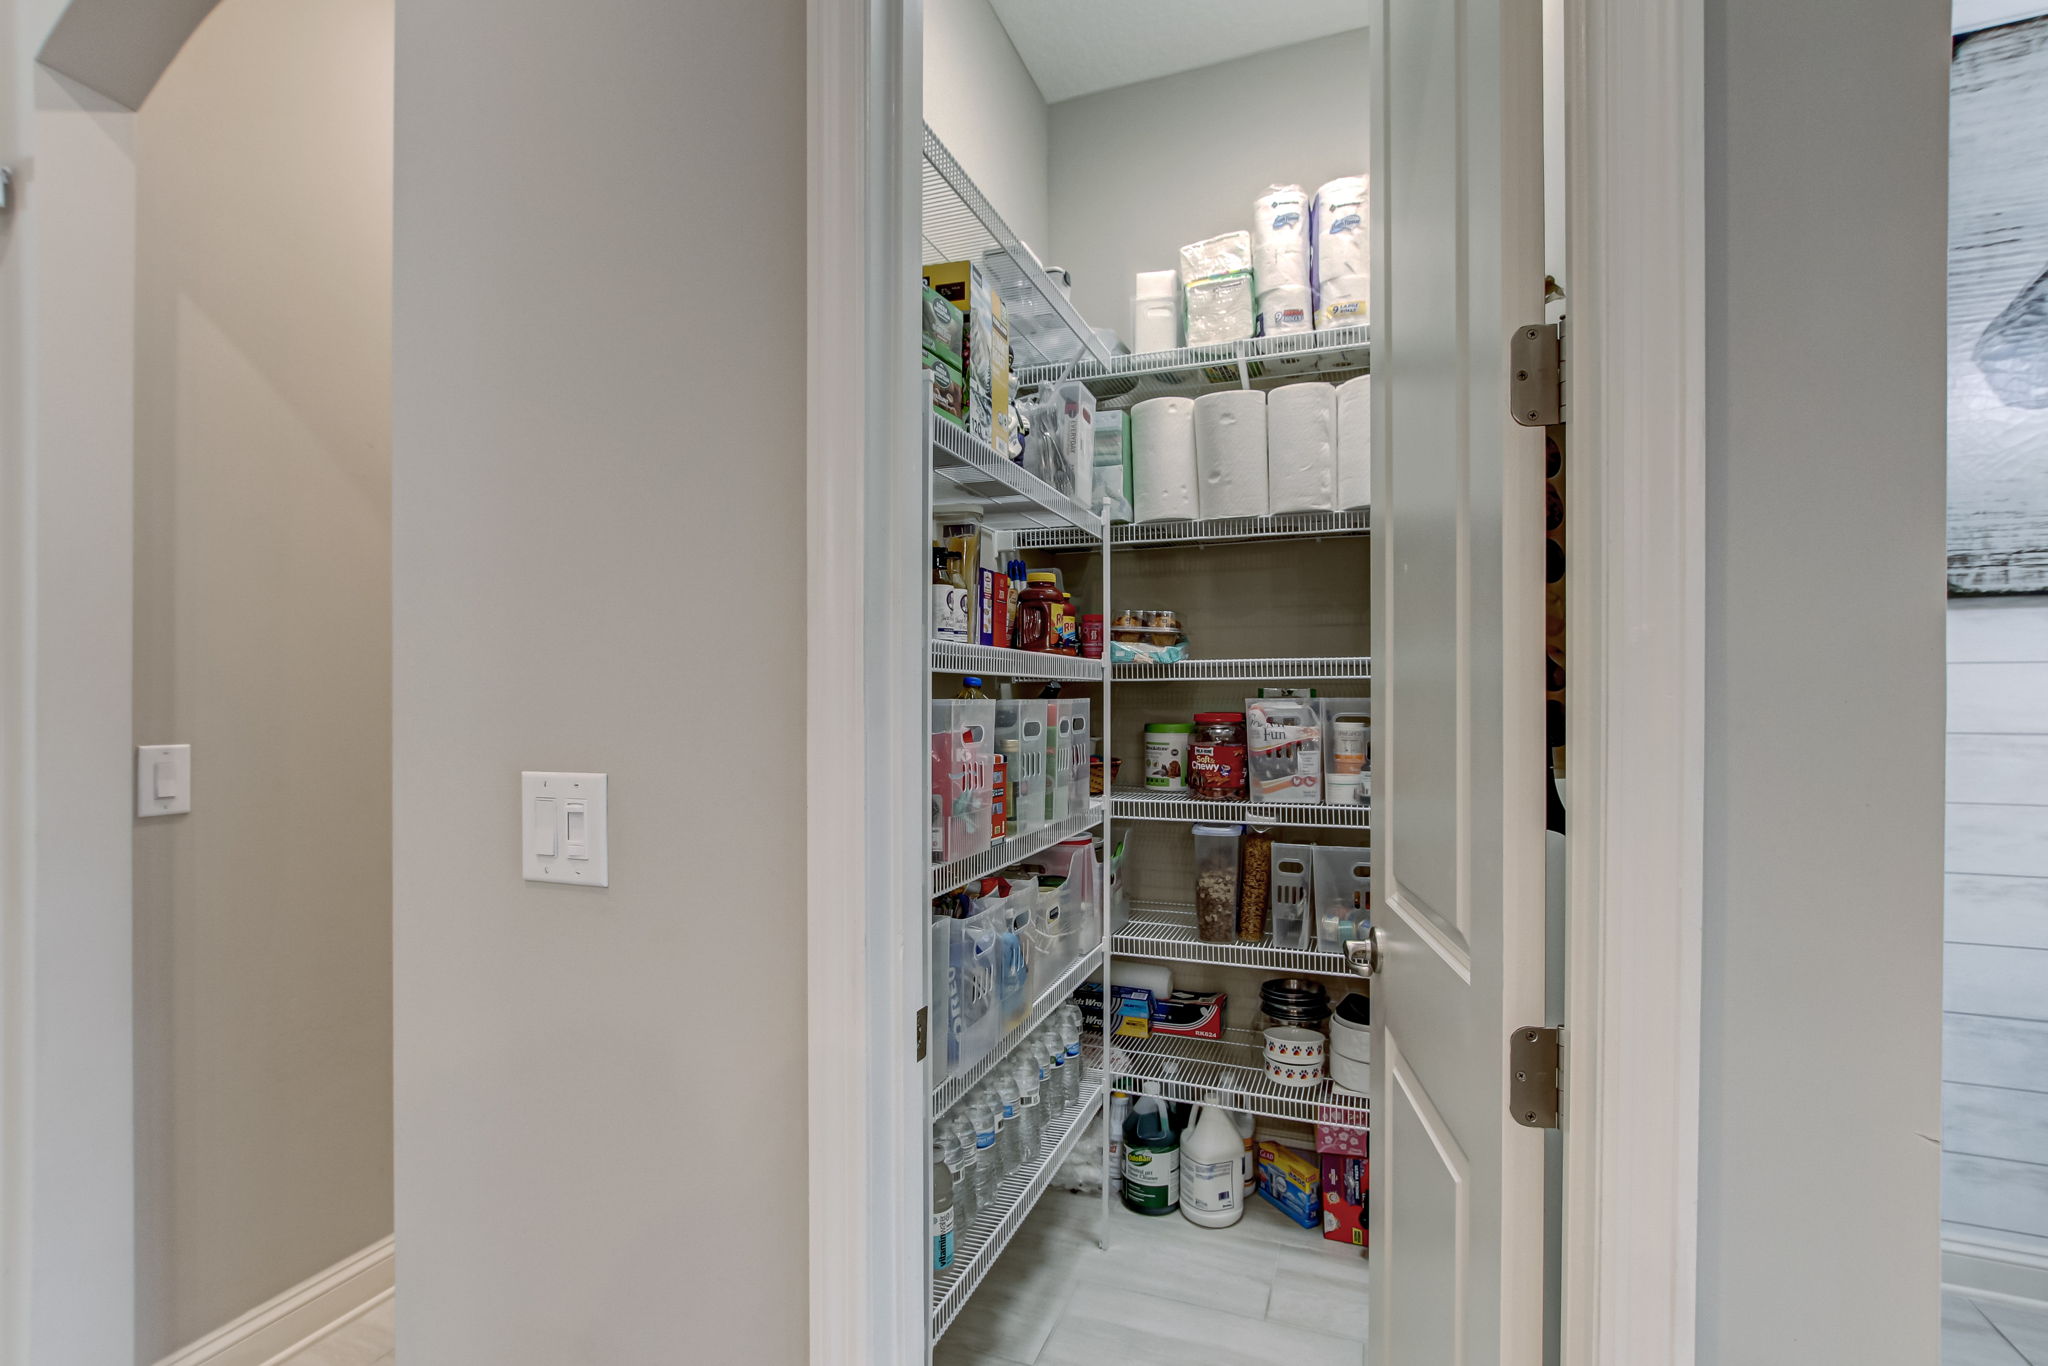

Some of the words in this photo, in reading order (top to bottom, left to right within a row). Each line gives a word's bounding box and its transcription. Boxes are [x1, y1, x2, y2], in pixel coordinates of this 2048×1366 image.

[1264, 727, 1286, 741] Fun
[1196, 755, 1210, 763] Soft
[1191, 760, 1220, 772] Chewy
[1085, 998, 1104, 1010] Wra
[1085, 1015, 1104, 1027] Wra
[1259, 1149, 1274, 1160] GLAD
